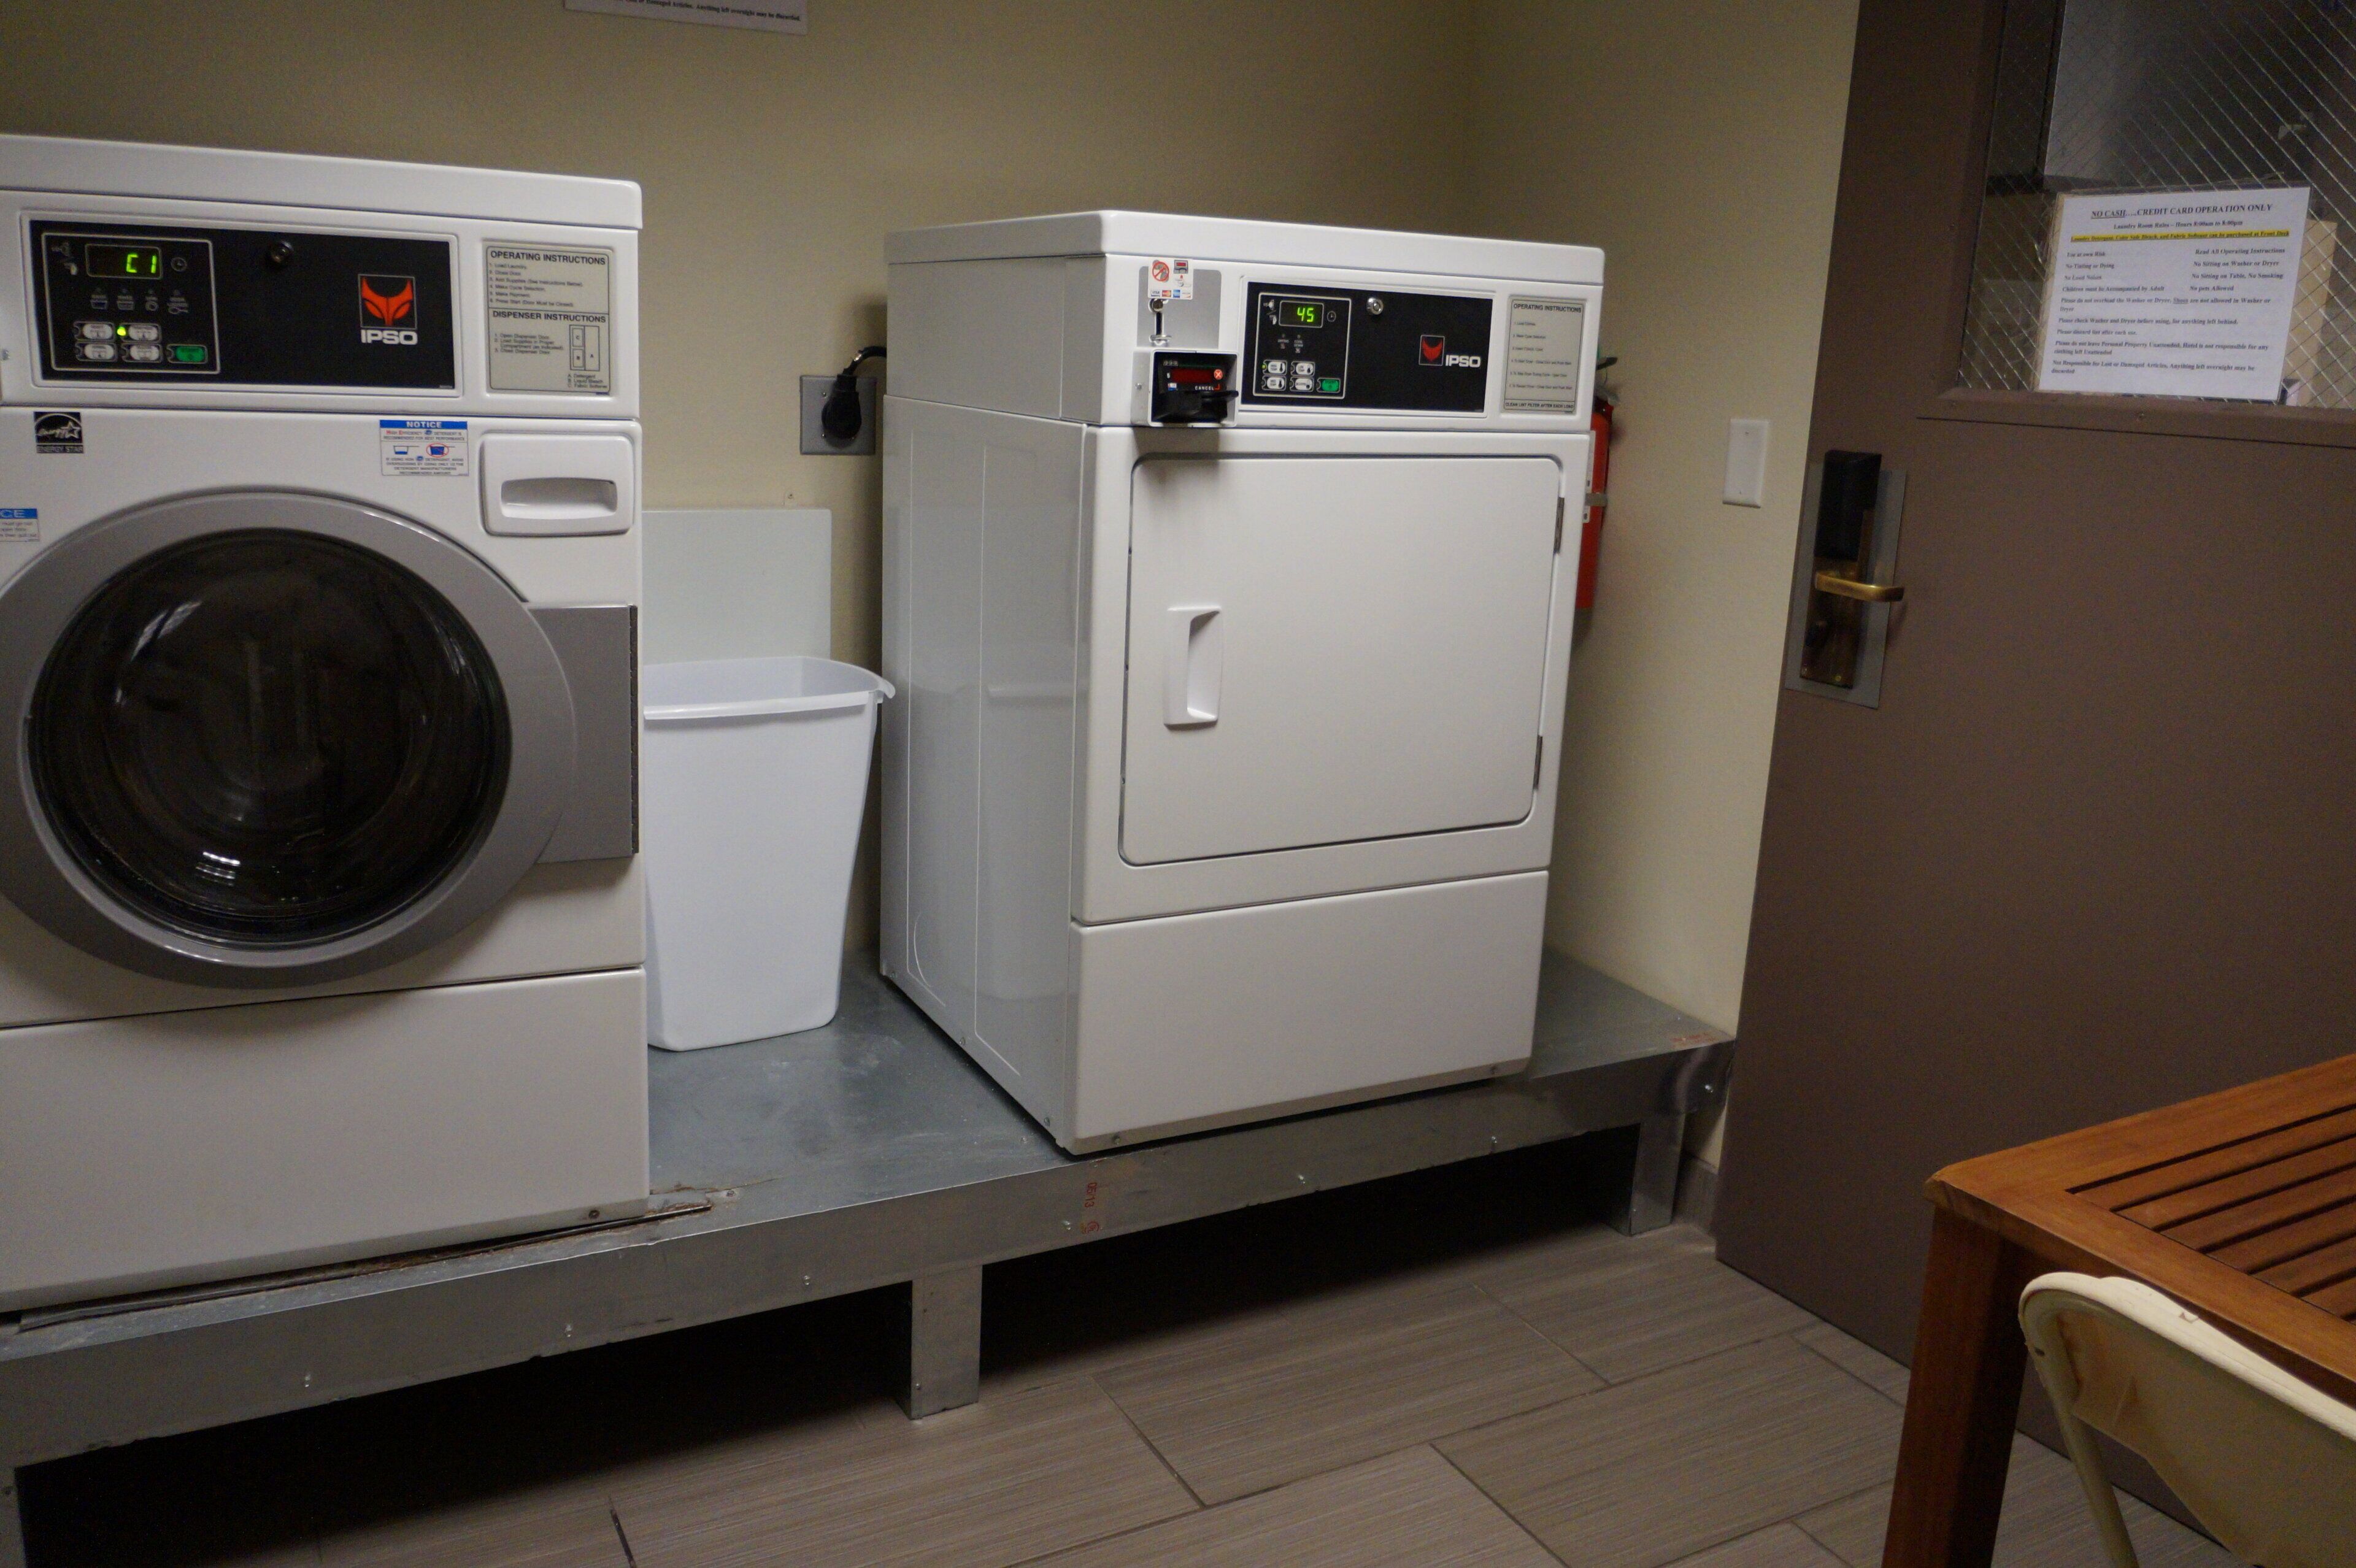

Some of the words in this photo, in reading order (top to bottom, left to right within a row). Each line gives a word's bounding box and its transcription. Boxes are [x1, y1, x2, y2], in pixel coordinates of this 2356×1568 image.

[2195, 205, 2245, 213] OPERATION
[490, 250, 541, 261] OPERATING
[543, 253, 606, 265] INSTRUCTIONS
[493, 310, 541, 320] DISPENSER
[544, 313, 606, 323] INSTRUCTIONS
[1297, 307, 1315, 323] 45
[360, 329, 418, 345] IPSO
[1445, 355, 1481, 369] IPSO
